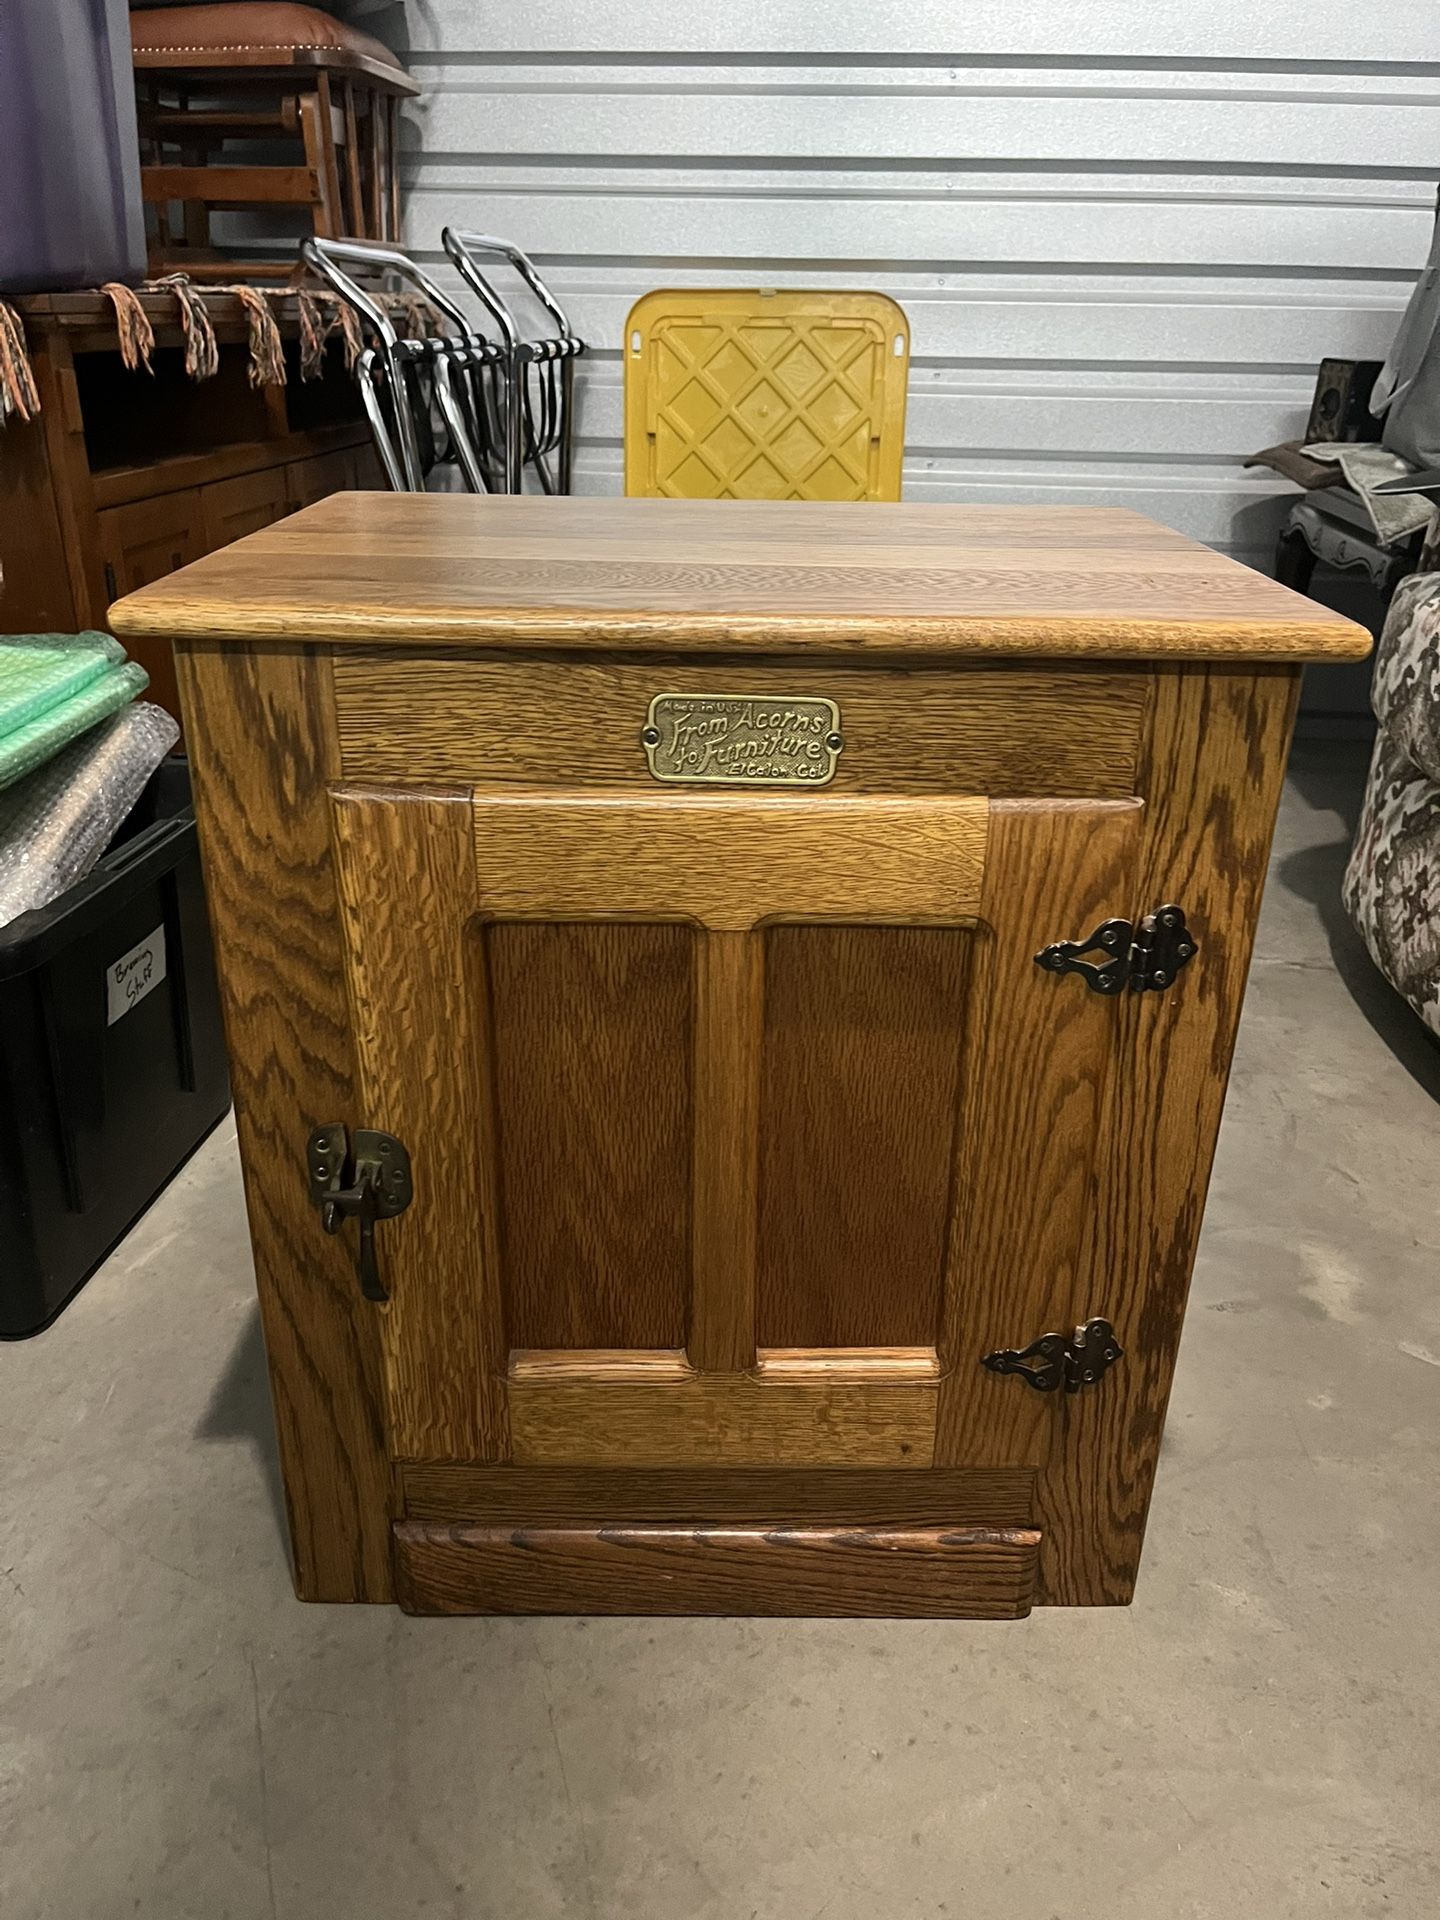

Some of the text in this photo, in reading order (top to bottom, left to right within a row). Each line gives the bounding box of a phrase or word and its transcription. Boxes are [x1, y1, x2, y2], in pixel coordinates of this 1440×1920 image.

[668, 702, 826, 757] From Acorns
[673, 729, 821, 774] to Furniture
